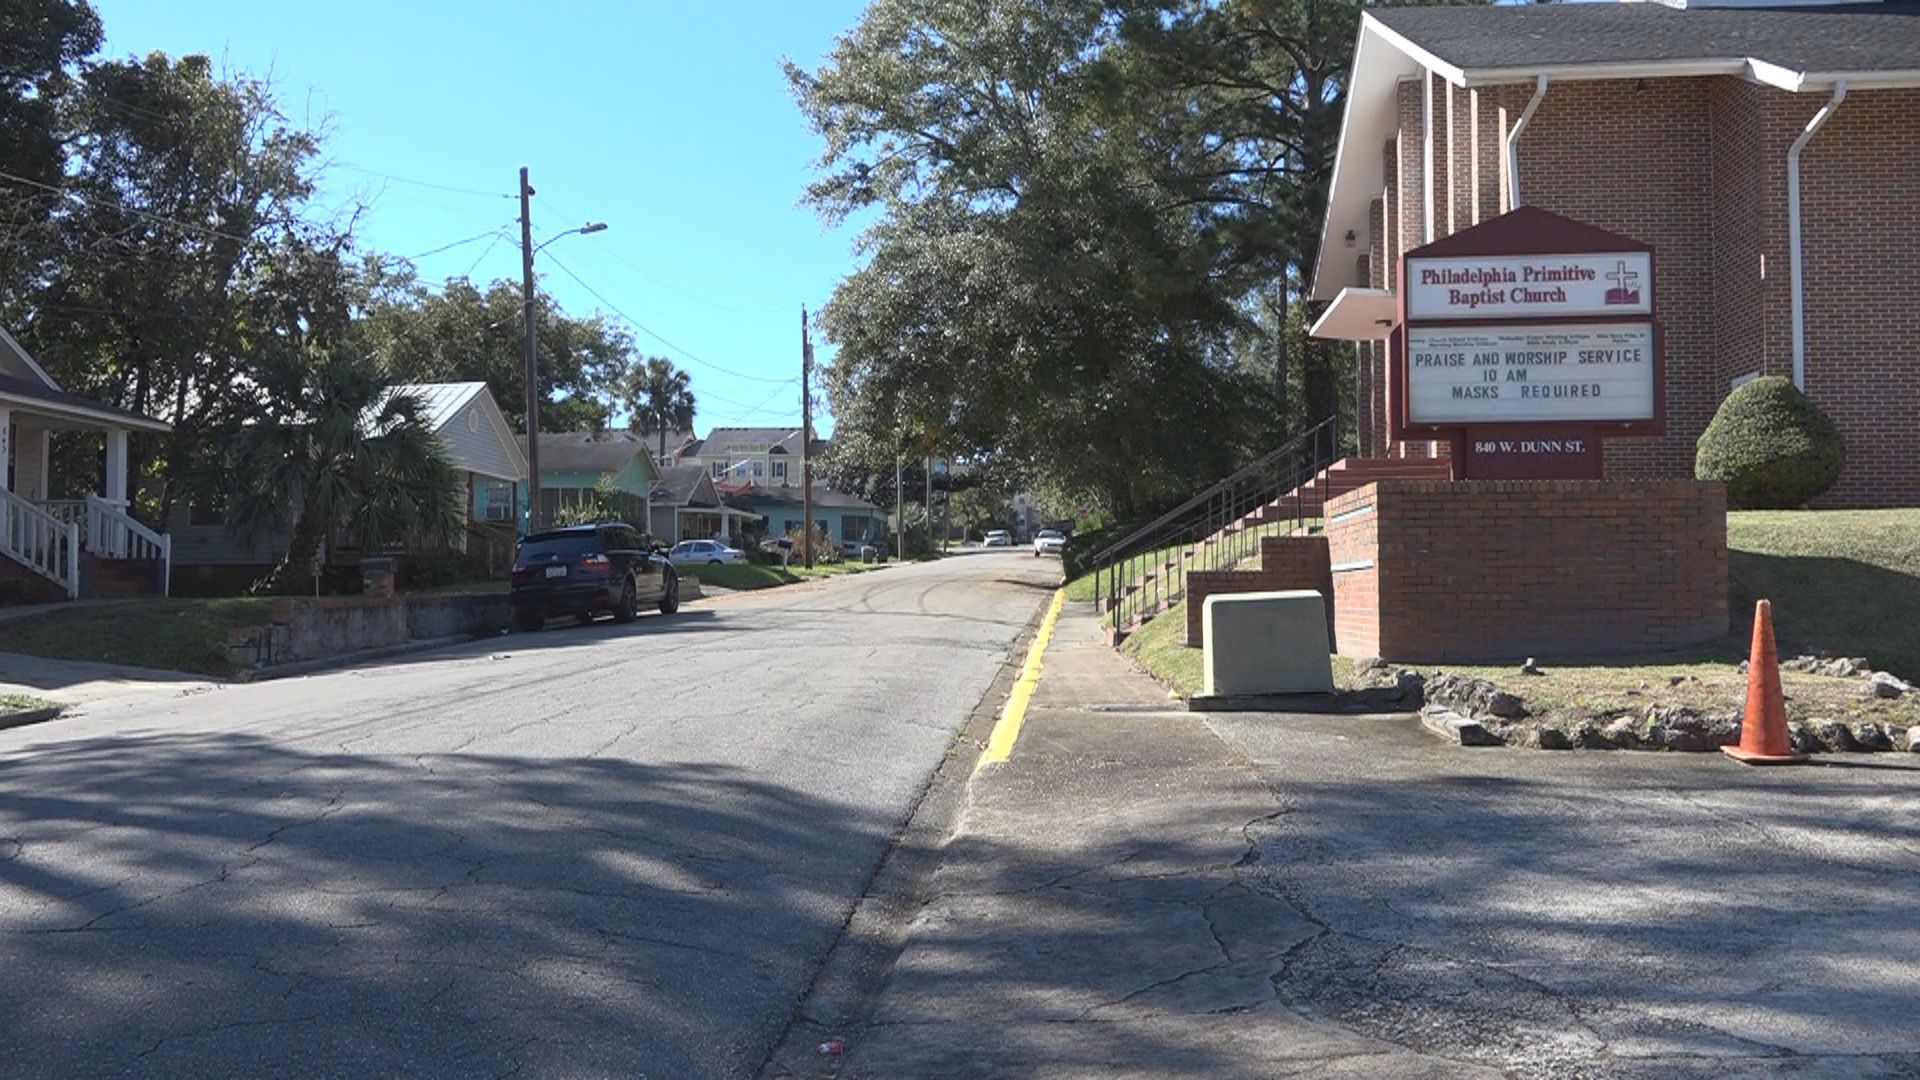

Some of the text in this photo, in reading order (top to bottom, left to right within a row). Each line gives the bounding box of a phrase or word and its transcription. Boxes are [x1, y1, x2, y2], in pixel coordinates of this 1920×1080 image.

[1421, 265, 1596, 287] Philadelphia Primitive
[1449, 286, 1567, 308] Baptist Church
[1415, 349, 1641, 367] PRAISE AND WORSHIP SERVICE
[1483, 368, 1527, 382] 10 AM
[1452, 383, 1601, 399] MASKS REQUIRED
[1475, 440, 1585, 453] 840 W. DUNN ST.
